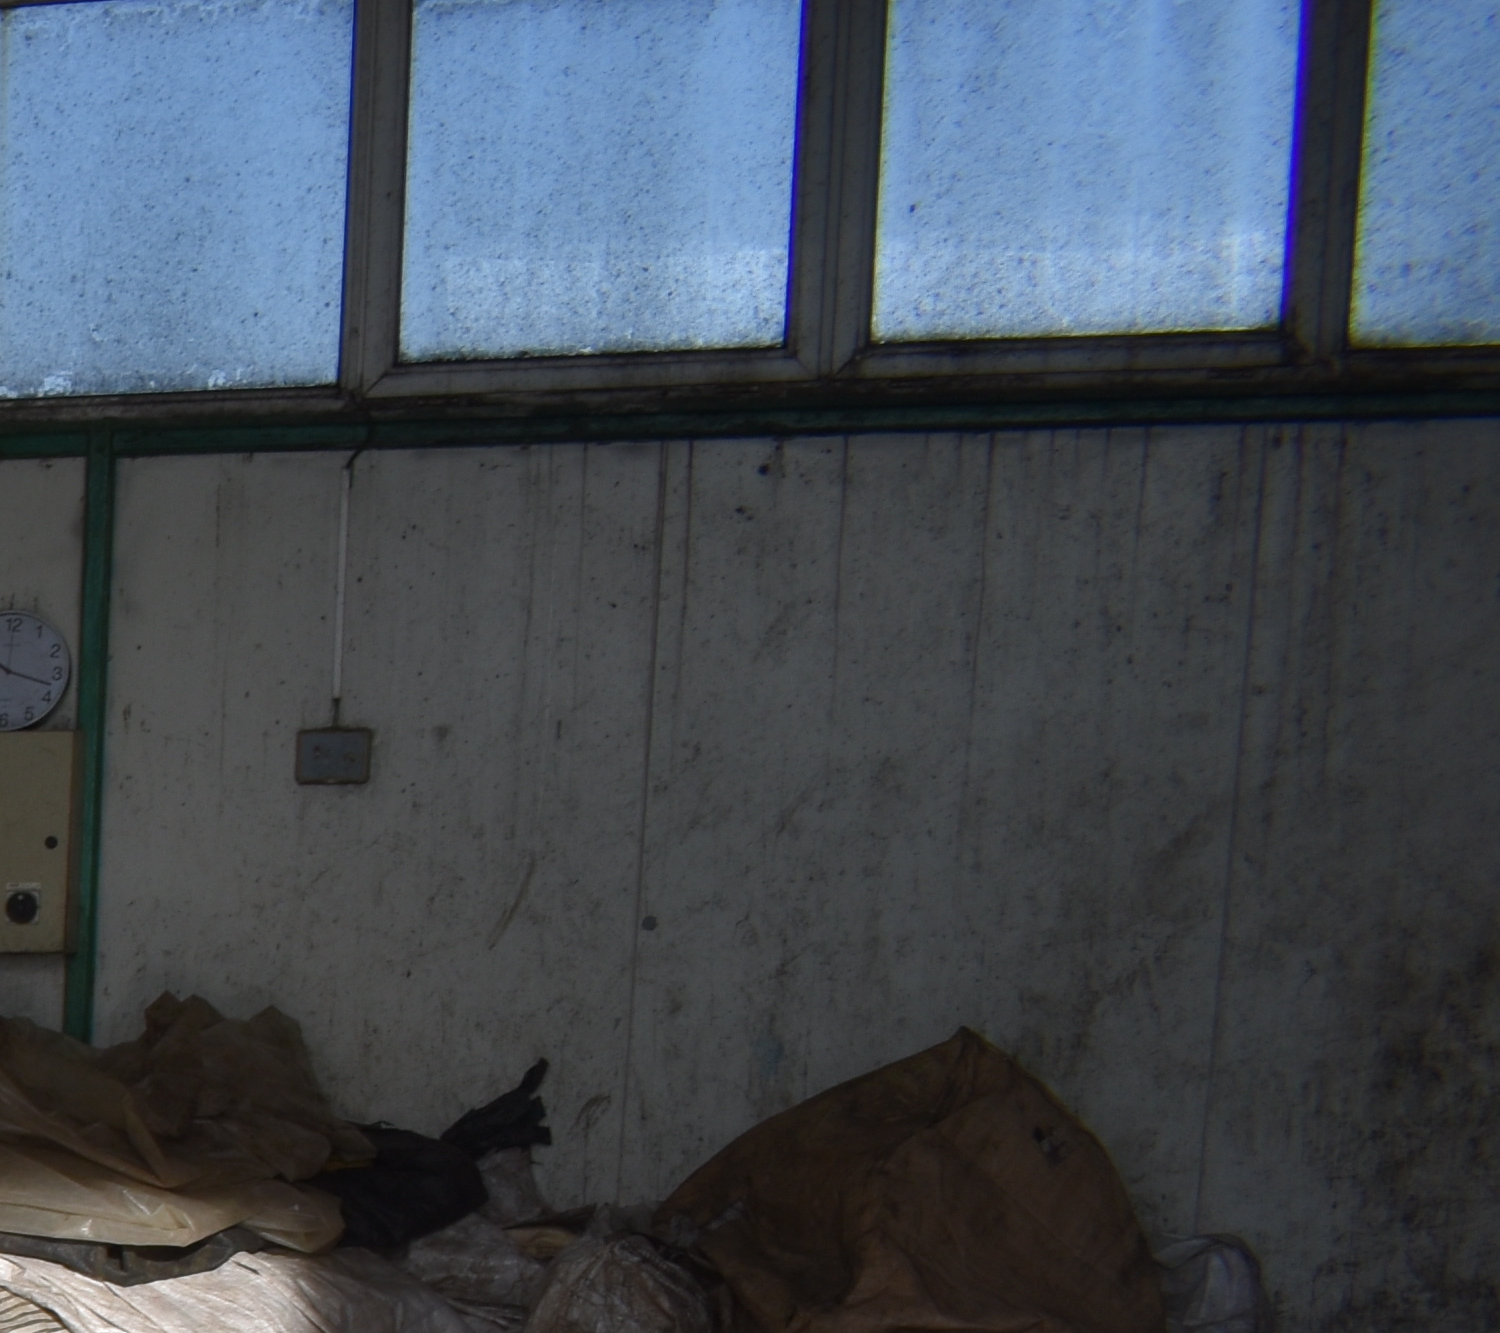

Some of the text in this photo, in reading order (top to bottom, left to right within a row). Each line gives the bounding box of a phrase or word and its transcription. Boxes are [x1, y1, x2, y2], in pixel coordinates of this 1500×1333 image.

[5, 617, 23, 633] 12
[35, 624, 43, 638] 1
[49, 643, 61, 658] 2
[51, 665, 63, 680] 3
[40, 689, 52, 703] 4
[23, 706, 34, 721] 5
